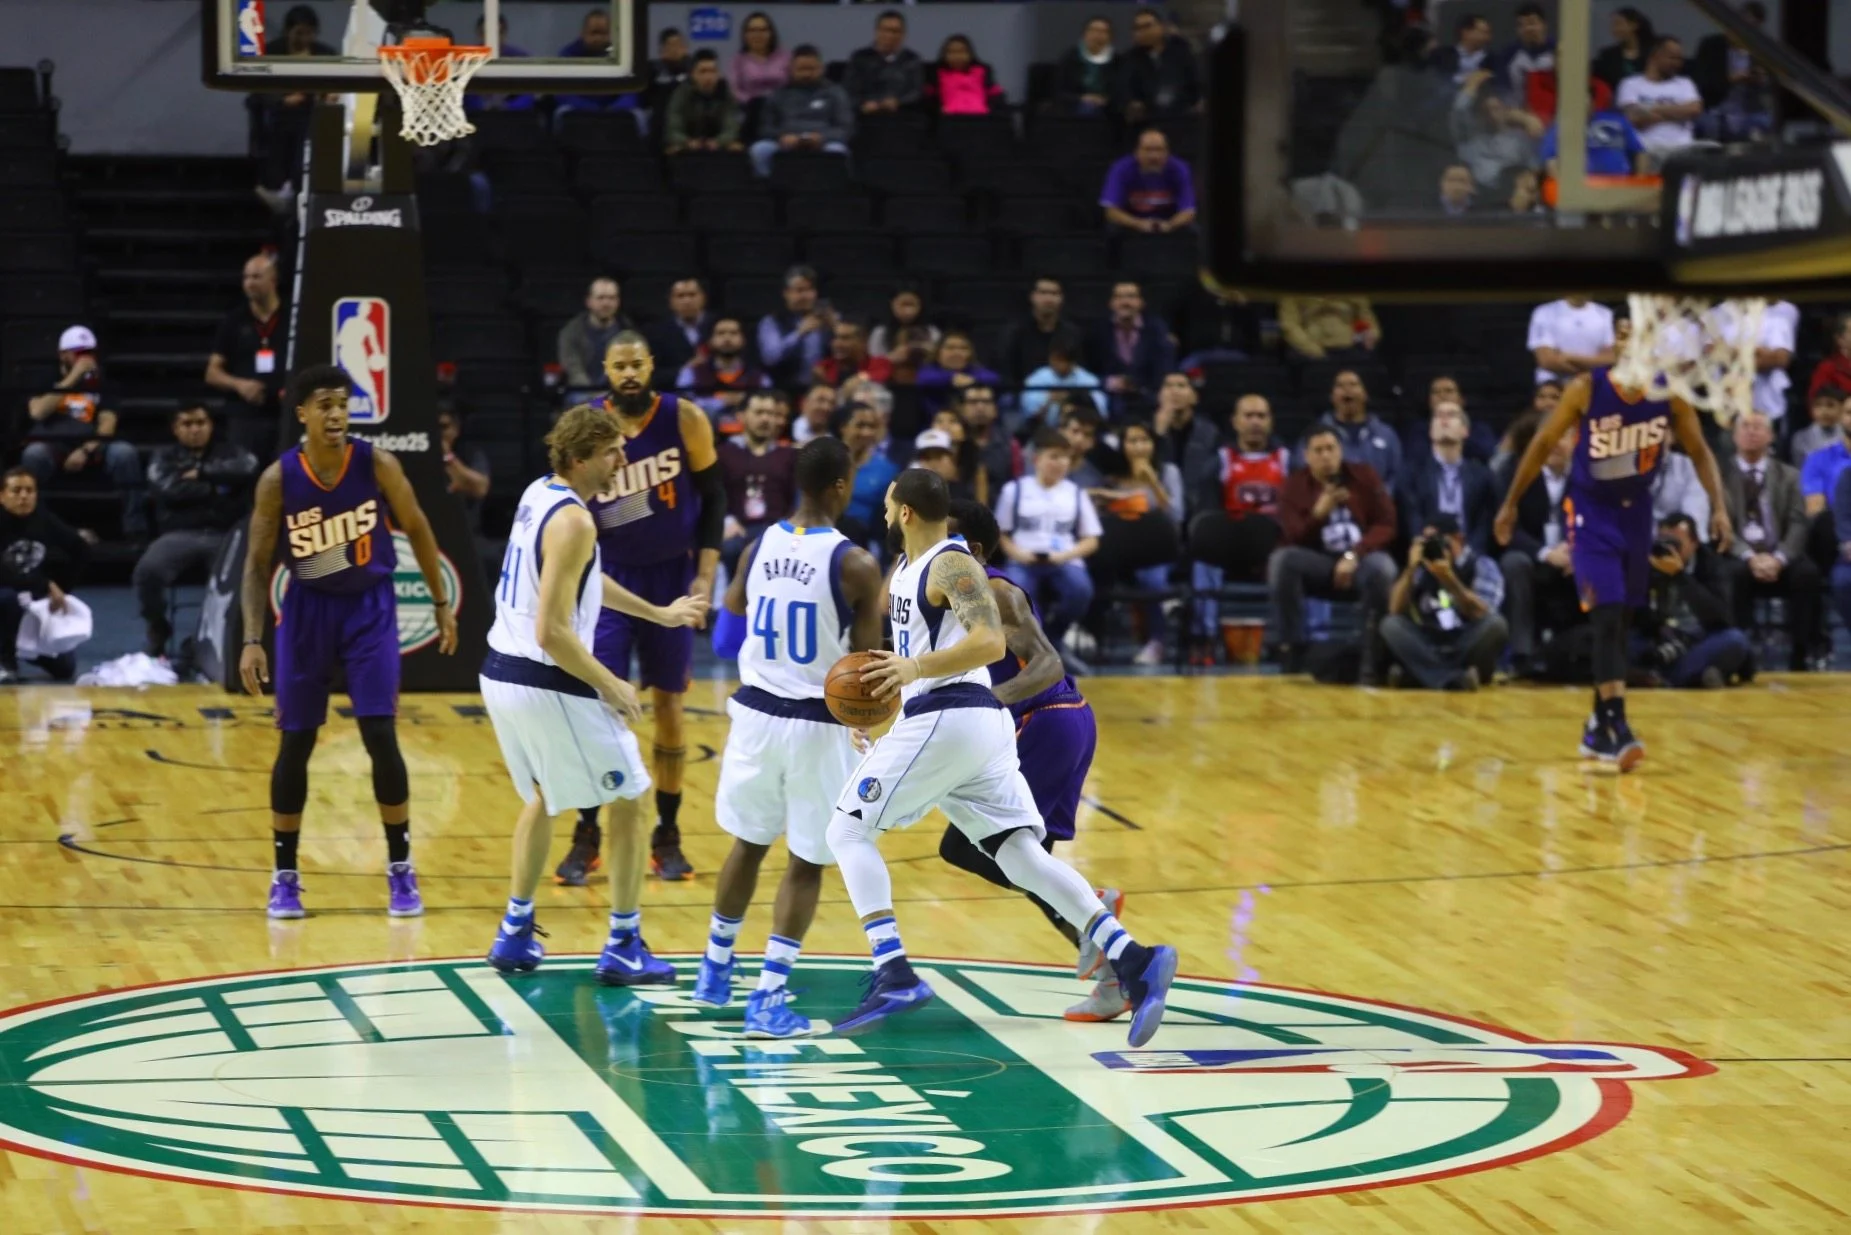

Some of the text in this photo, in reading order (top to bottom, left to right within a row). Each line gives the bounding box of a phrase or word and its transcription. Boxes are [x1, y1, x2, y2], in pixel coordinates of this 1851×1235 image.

[324, 208, 402, 228] SPALDING
[1589, 416, 1668, 458] SUNS
[1590, 413, 1622, 433] LOS
[657, 480, 677, 509] 4
[286, 506, 322, 530] LOS
[288, 499, 378, 558] SUNS
[355, 533, 372, 566] 0
[500, 543, 522, 609] 41
[763, 557, 816, 586] BARNES
[753, 595, 818, 665] 40
[899, 630, 910, 658] 8
[665, 1019, 868, 1056] DE
[711, 1061, 1014, 1183] MÉXICO
